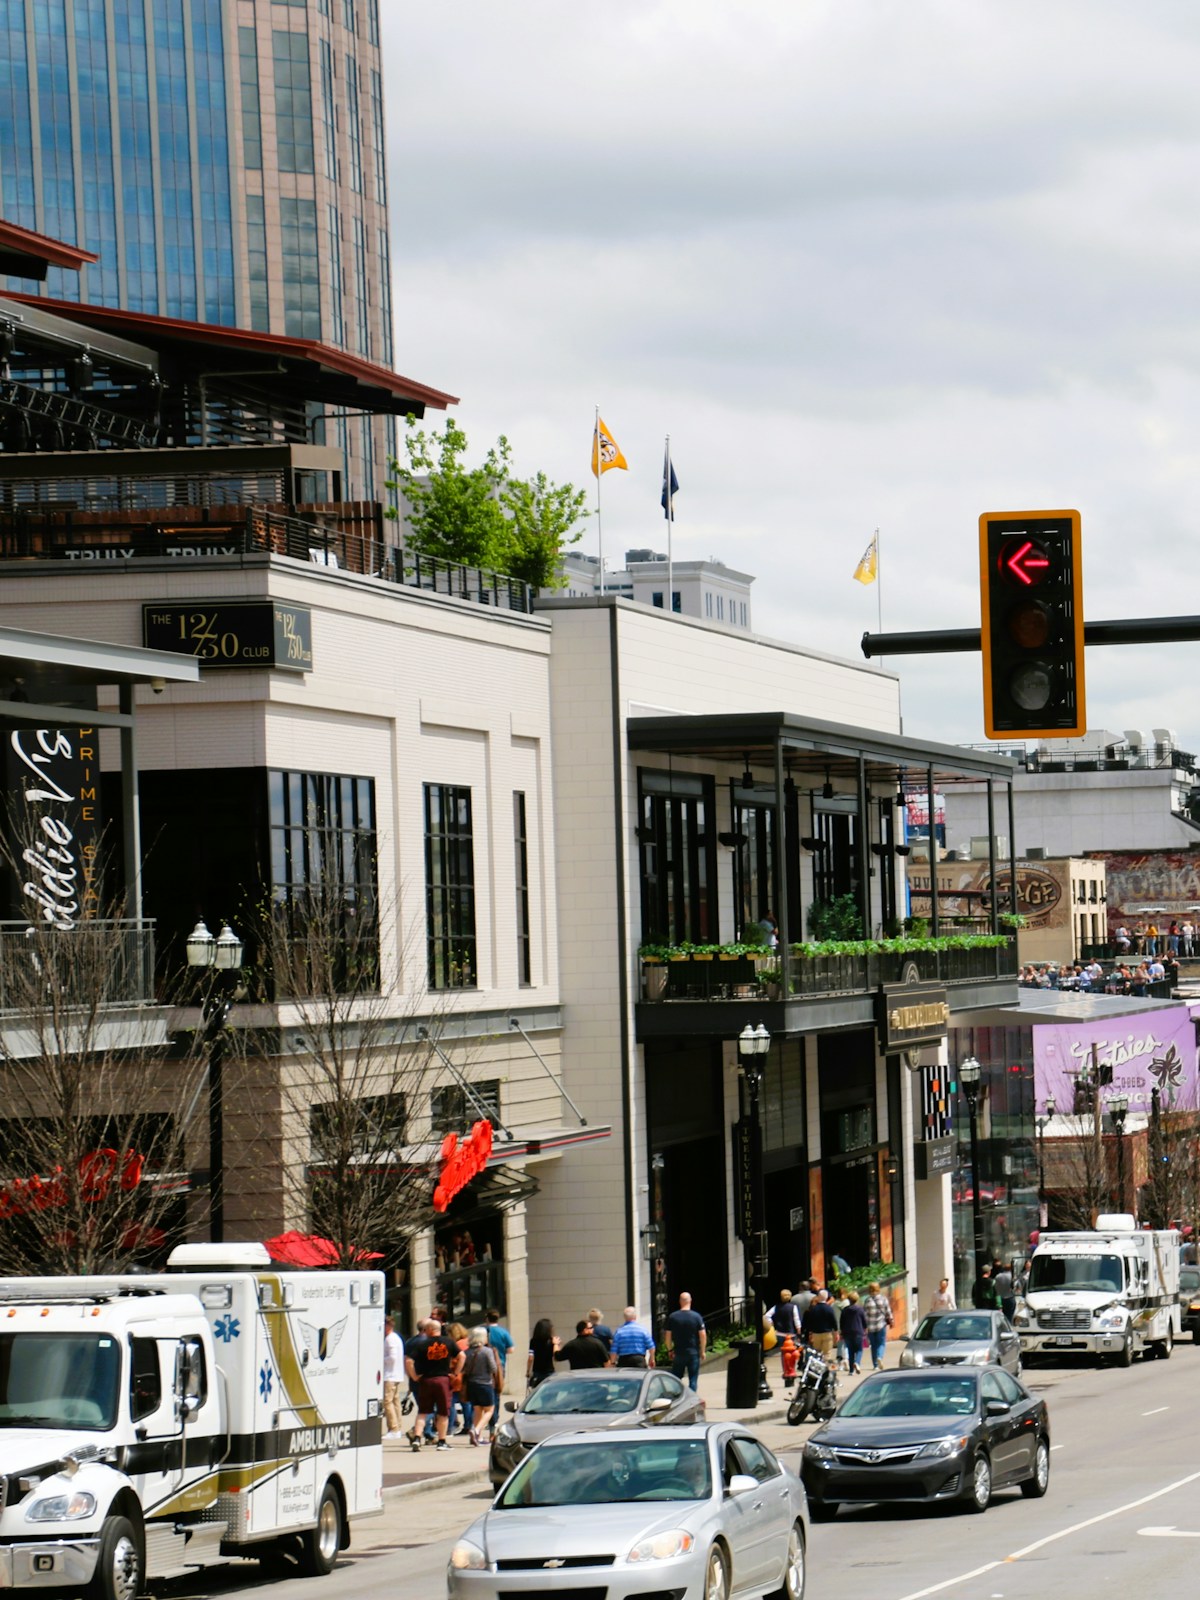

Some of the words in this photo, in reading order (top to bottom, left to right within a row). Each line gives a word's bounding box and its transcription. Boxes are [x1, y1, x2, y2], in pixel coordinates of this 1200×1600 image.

[152, 614, 171, 625] THE
[242, 646, 270, 658] CLUB
[1070, 1035, 1163, 1068] Totsies
[742, 1127, 752, 1180] TWELVE
[744, 1184, 753, 1237] THIRTY
[288, 1425, 351, 1454] AMBULANCE
